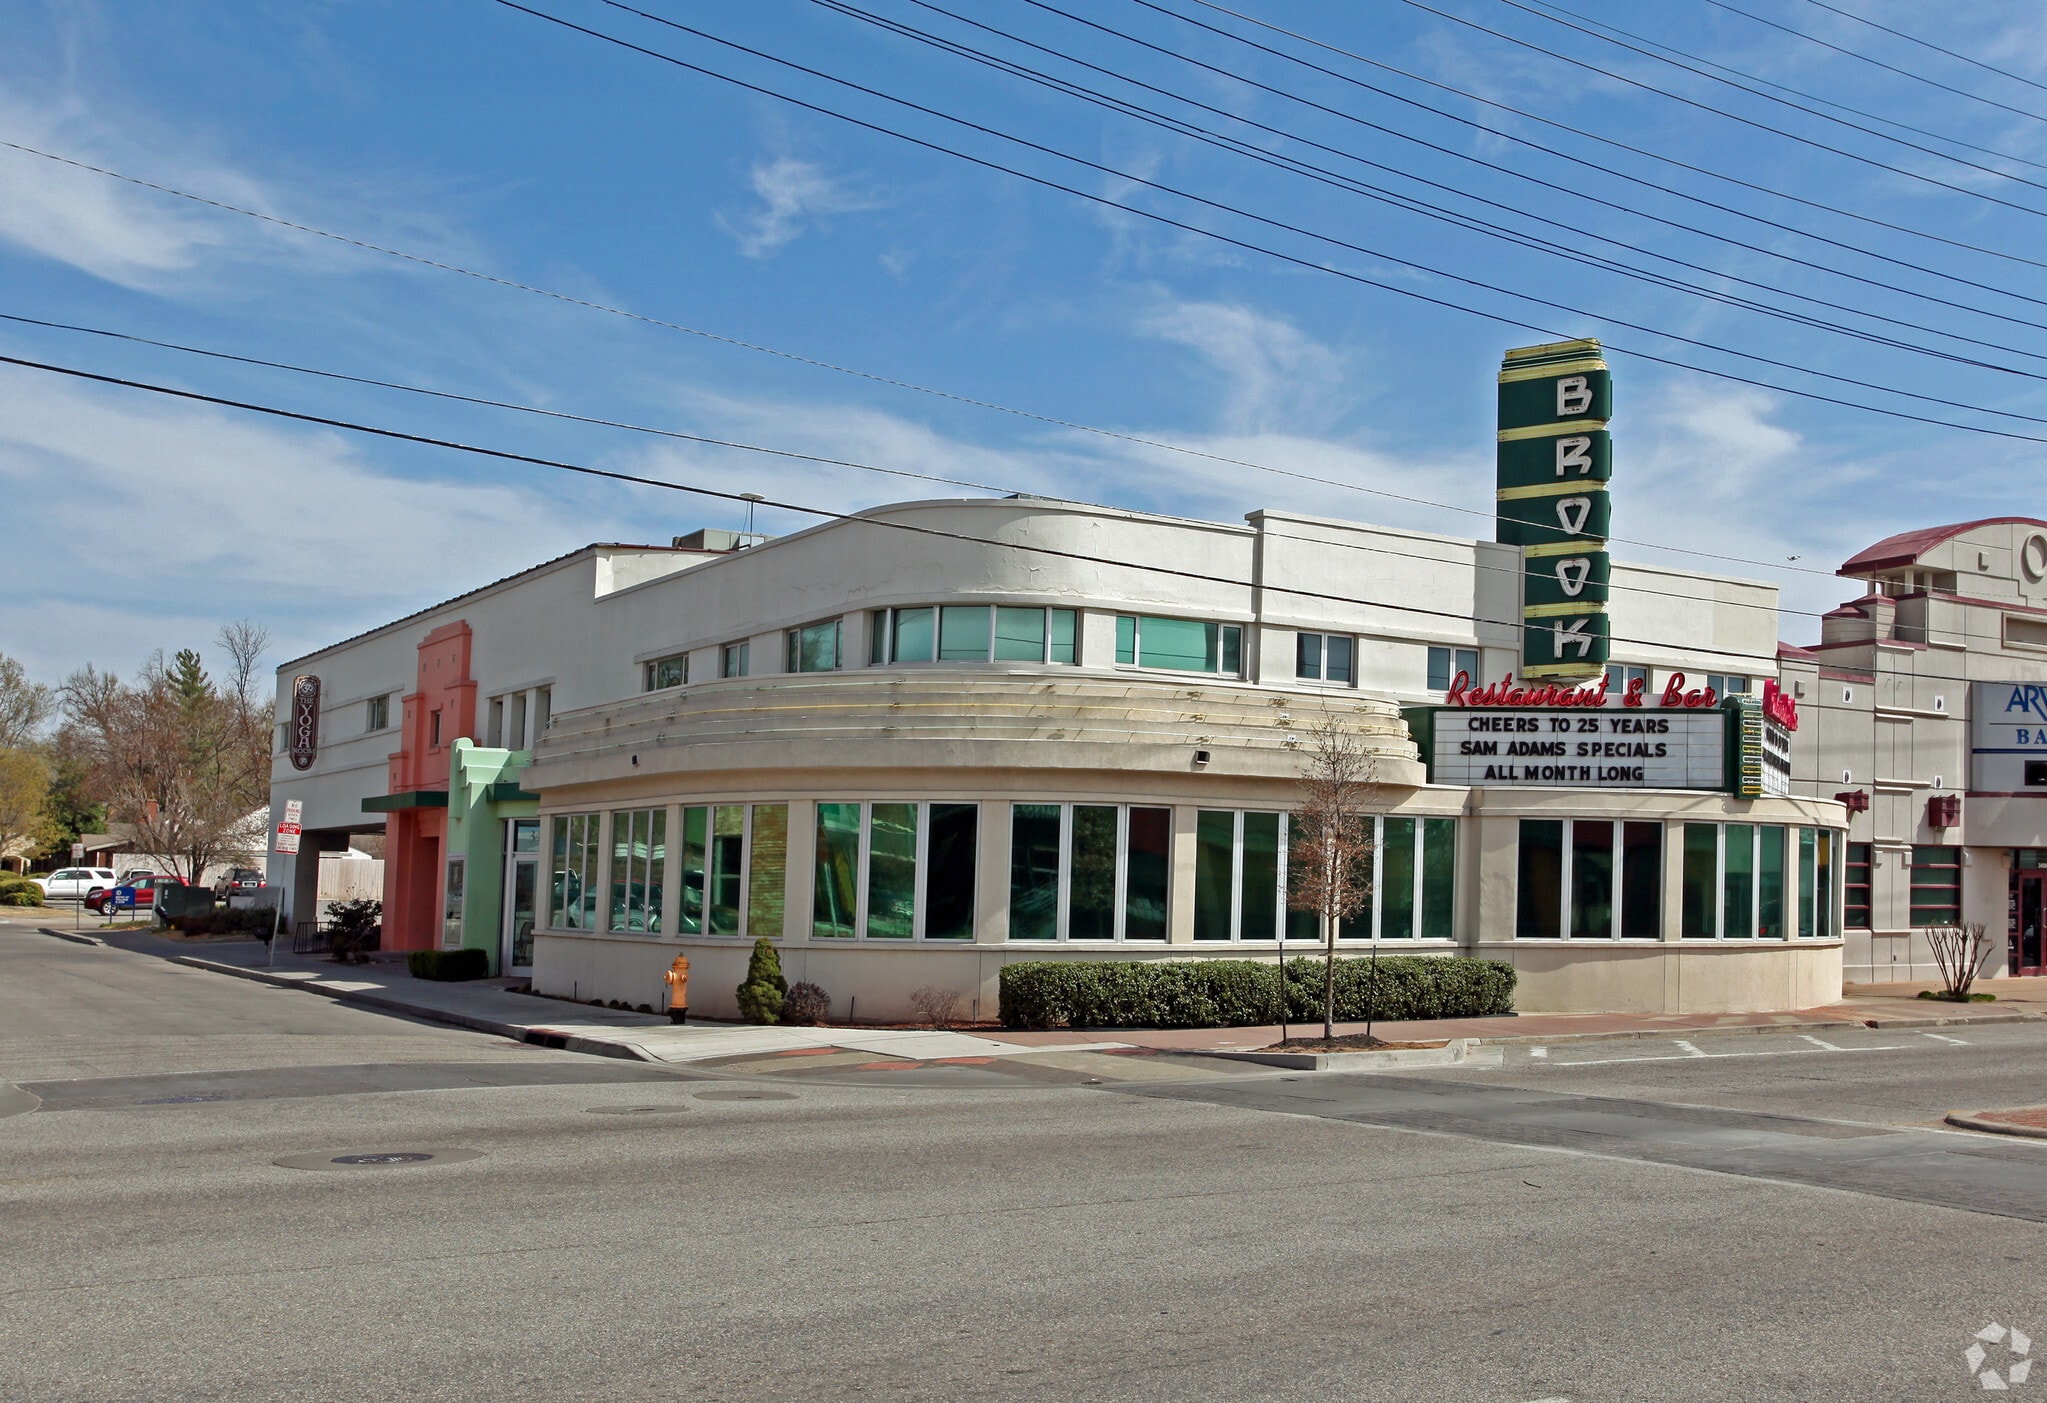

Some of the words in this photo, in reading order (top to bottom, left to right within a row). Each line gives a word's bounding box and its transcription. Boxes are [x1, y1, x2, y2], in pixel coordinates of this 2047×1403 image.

[1553, 375, 1593, 659] BROOK
[1447, 669, 1609, 708] Restaurant
[1623, 677, 1643, 707] &
[1659, 672, 1717, 708] Bar
[298, 703, 313, 748] YOGA
[1468, 716, 1539, 733] CHEERS
[1549, 717, 1571, 733] TO
[1577, 717, 1600, 733] 25
[1610, 718, 1669, 734] YEARS
[1460, 740, 1498, 756] SAM
[1506, 741, 1566, 757] ADAMS
[1576, 742, 1667, 758] SPECIALS
[1484, 764, 1519, 780] ALL
[1524, 765, 1591, 781] MONTH
[1599, 766, 1644, 781] LONG
